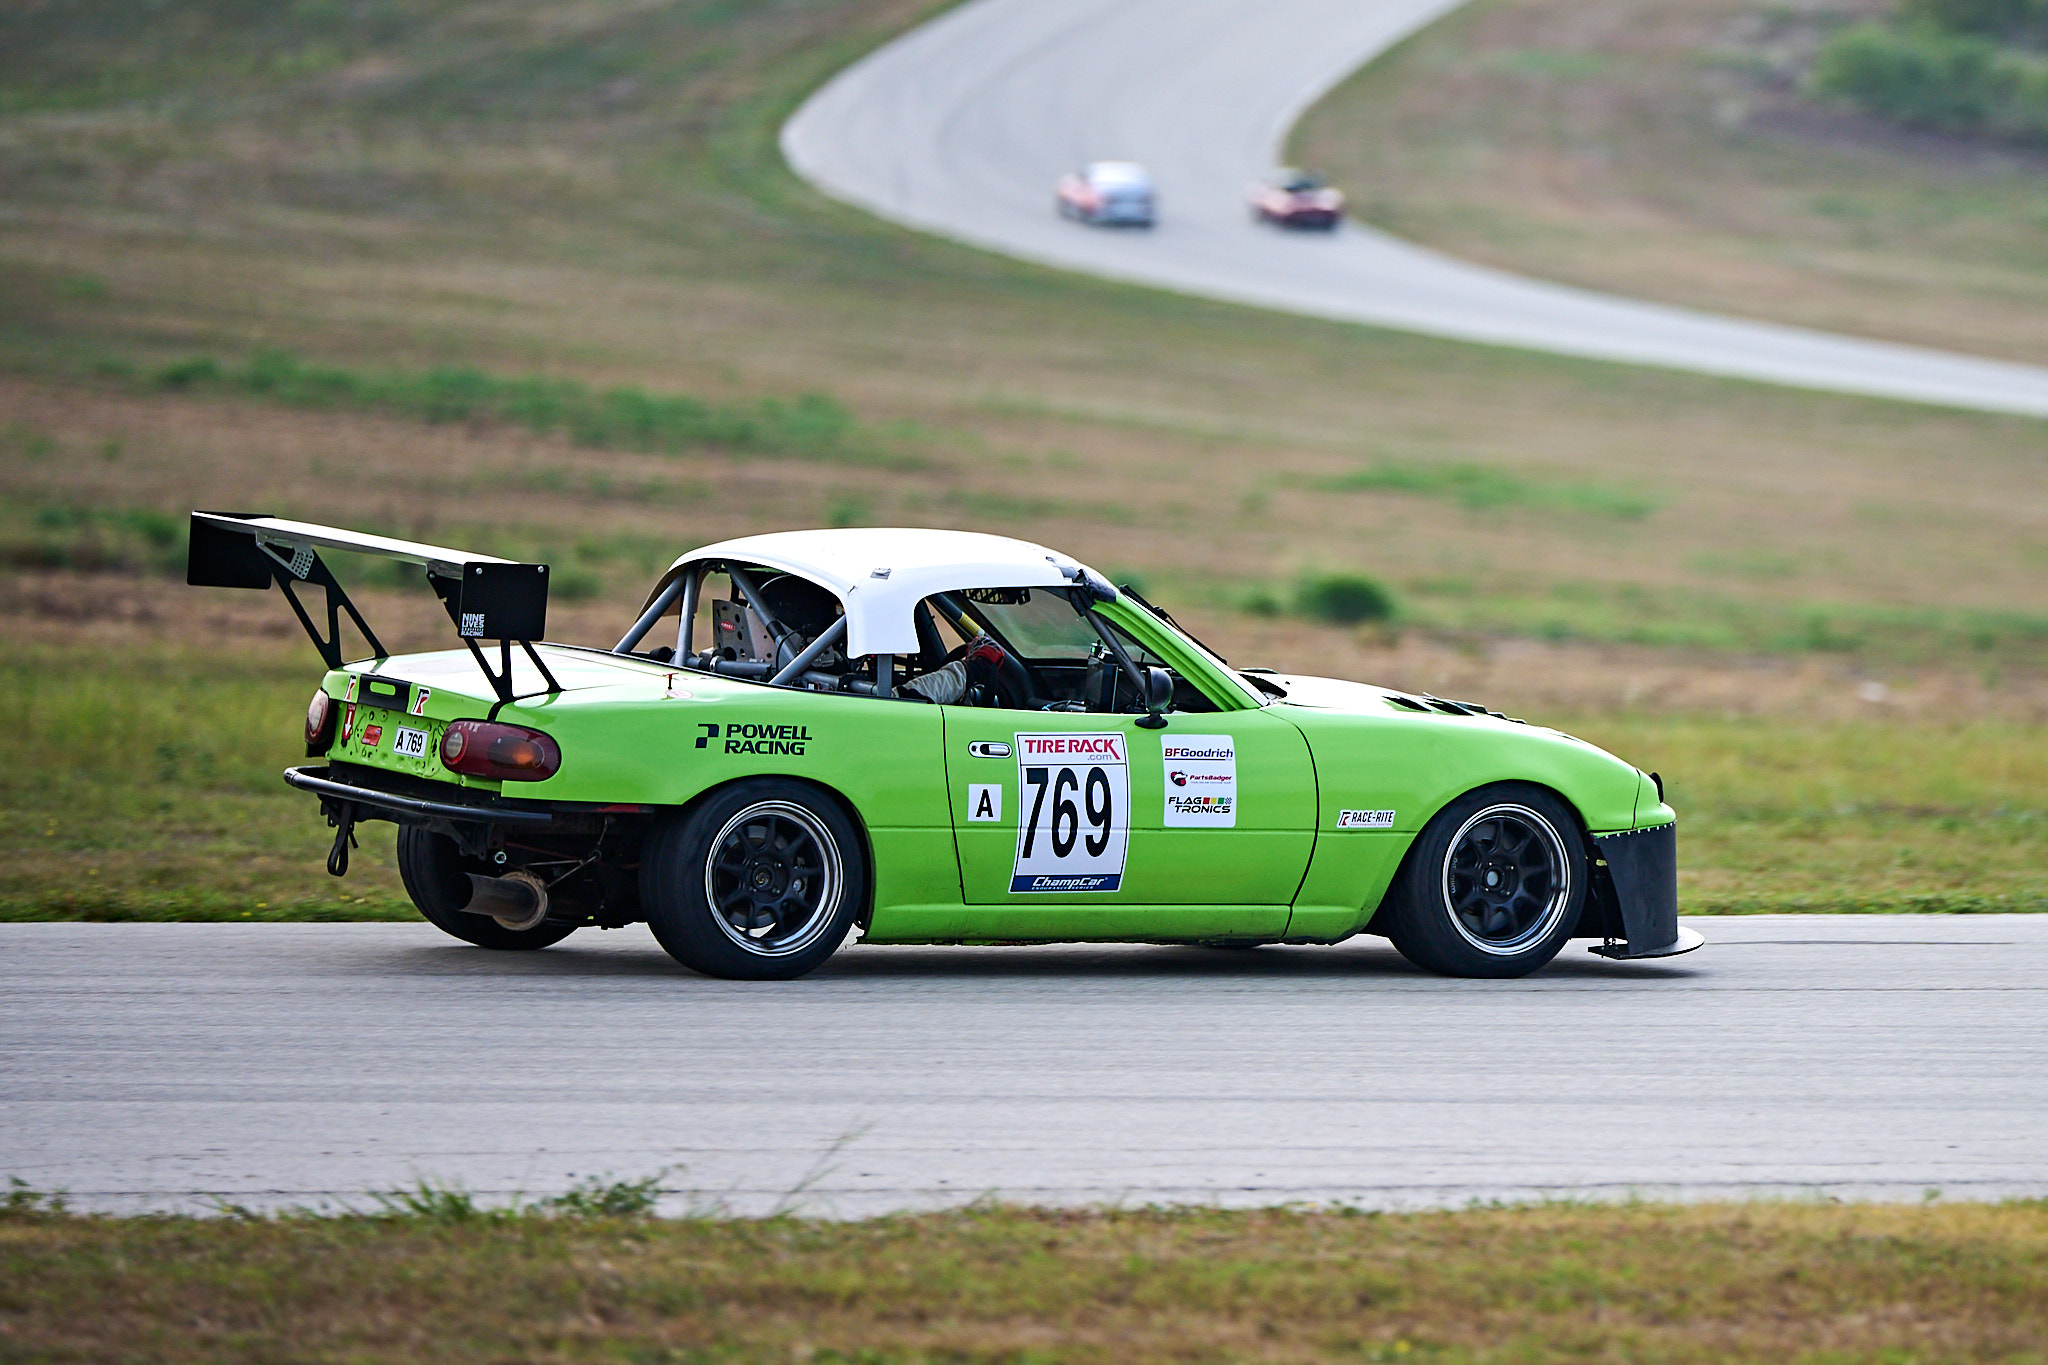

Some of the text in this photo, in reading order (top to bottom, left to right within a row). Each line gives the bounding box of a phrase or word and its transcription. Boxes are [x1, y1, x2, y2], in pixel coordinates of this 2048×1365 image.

[462, 613, 485, 622] NINE
[462, 620, 484, 628] LIVES
[726, 724, 813, 740] POWELL
[395, 731, 404, 750] A
[406, 732, 423, 754] 769
[725, 740, 805, 755] RACING
[1025, 739, 1121, 760] TIRE RACK
[1165, 748, 1233, 758] BFGoodrich
[976, 789, 993, 817] A
[1168, 797, 1202, 805] FLAG
[1022, 767, 1112, 858] 769
[1175, 805, 1231, 814] TRONICS
[1352, 812, 1394, 823] RACE-RITE
[1032, 877, 1104, 889] ChampCar
